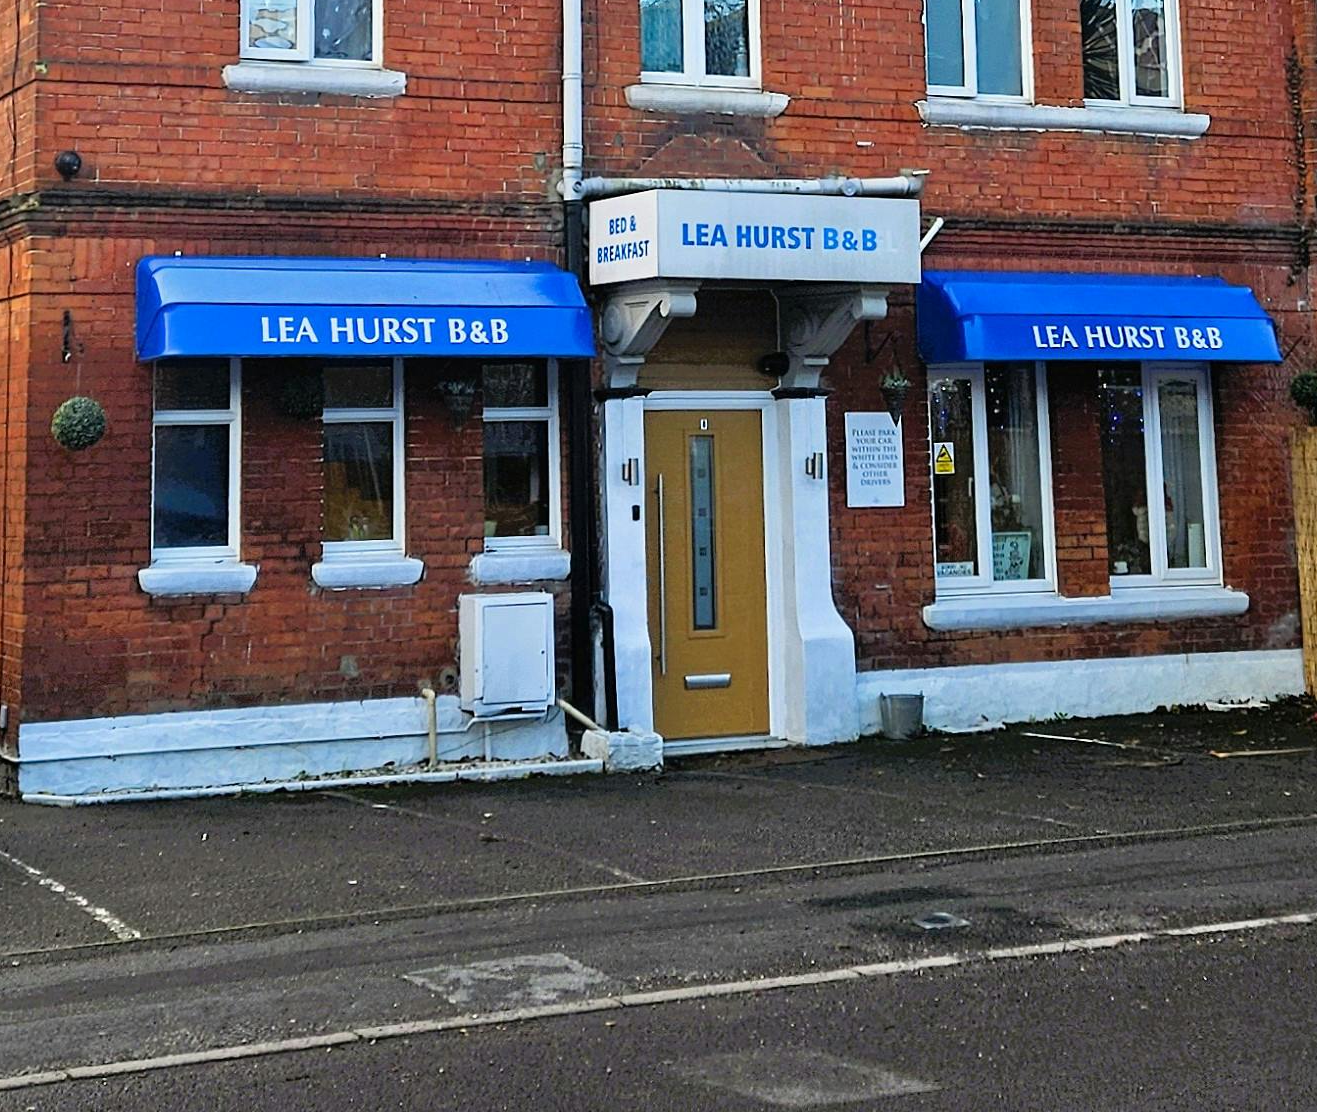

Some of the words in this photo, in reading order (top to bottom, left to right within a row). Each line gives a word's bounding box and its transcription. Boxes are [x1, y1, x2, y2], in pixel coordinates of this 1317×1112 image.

[609, 216, 627, 236] BED
[629, 215, 637, 232] &
[682, 222, 729, 248] LEA
[735, 224, 816, 250] HURST
[823, 227, 878, 252] B&B
[597, 239, 650, 264] BREAKFAST
[261, 316, 319, 344] LEA
[330, 317, 436, 345] HURST
[448, 318, 510, 345] B&B
[1032, 325, 1079, 349] LEA
[1084, 326, 1166, 349] HURST
[1174, 327, 1224, 350] B&B
[852, 429, 876, 437] PLEASE
[851, 462, 859, 470] &
[862, 470, 888, 478] OTHER
